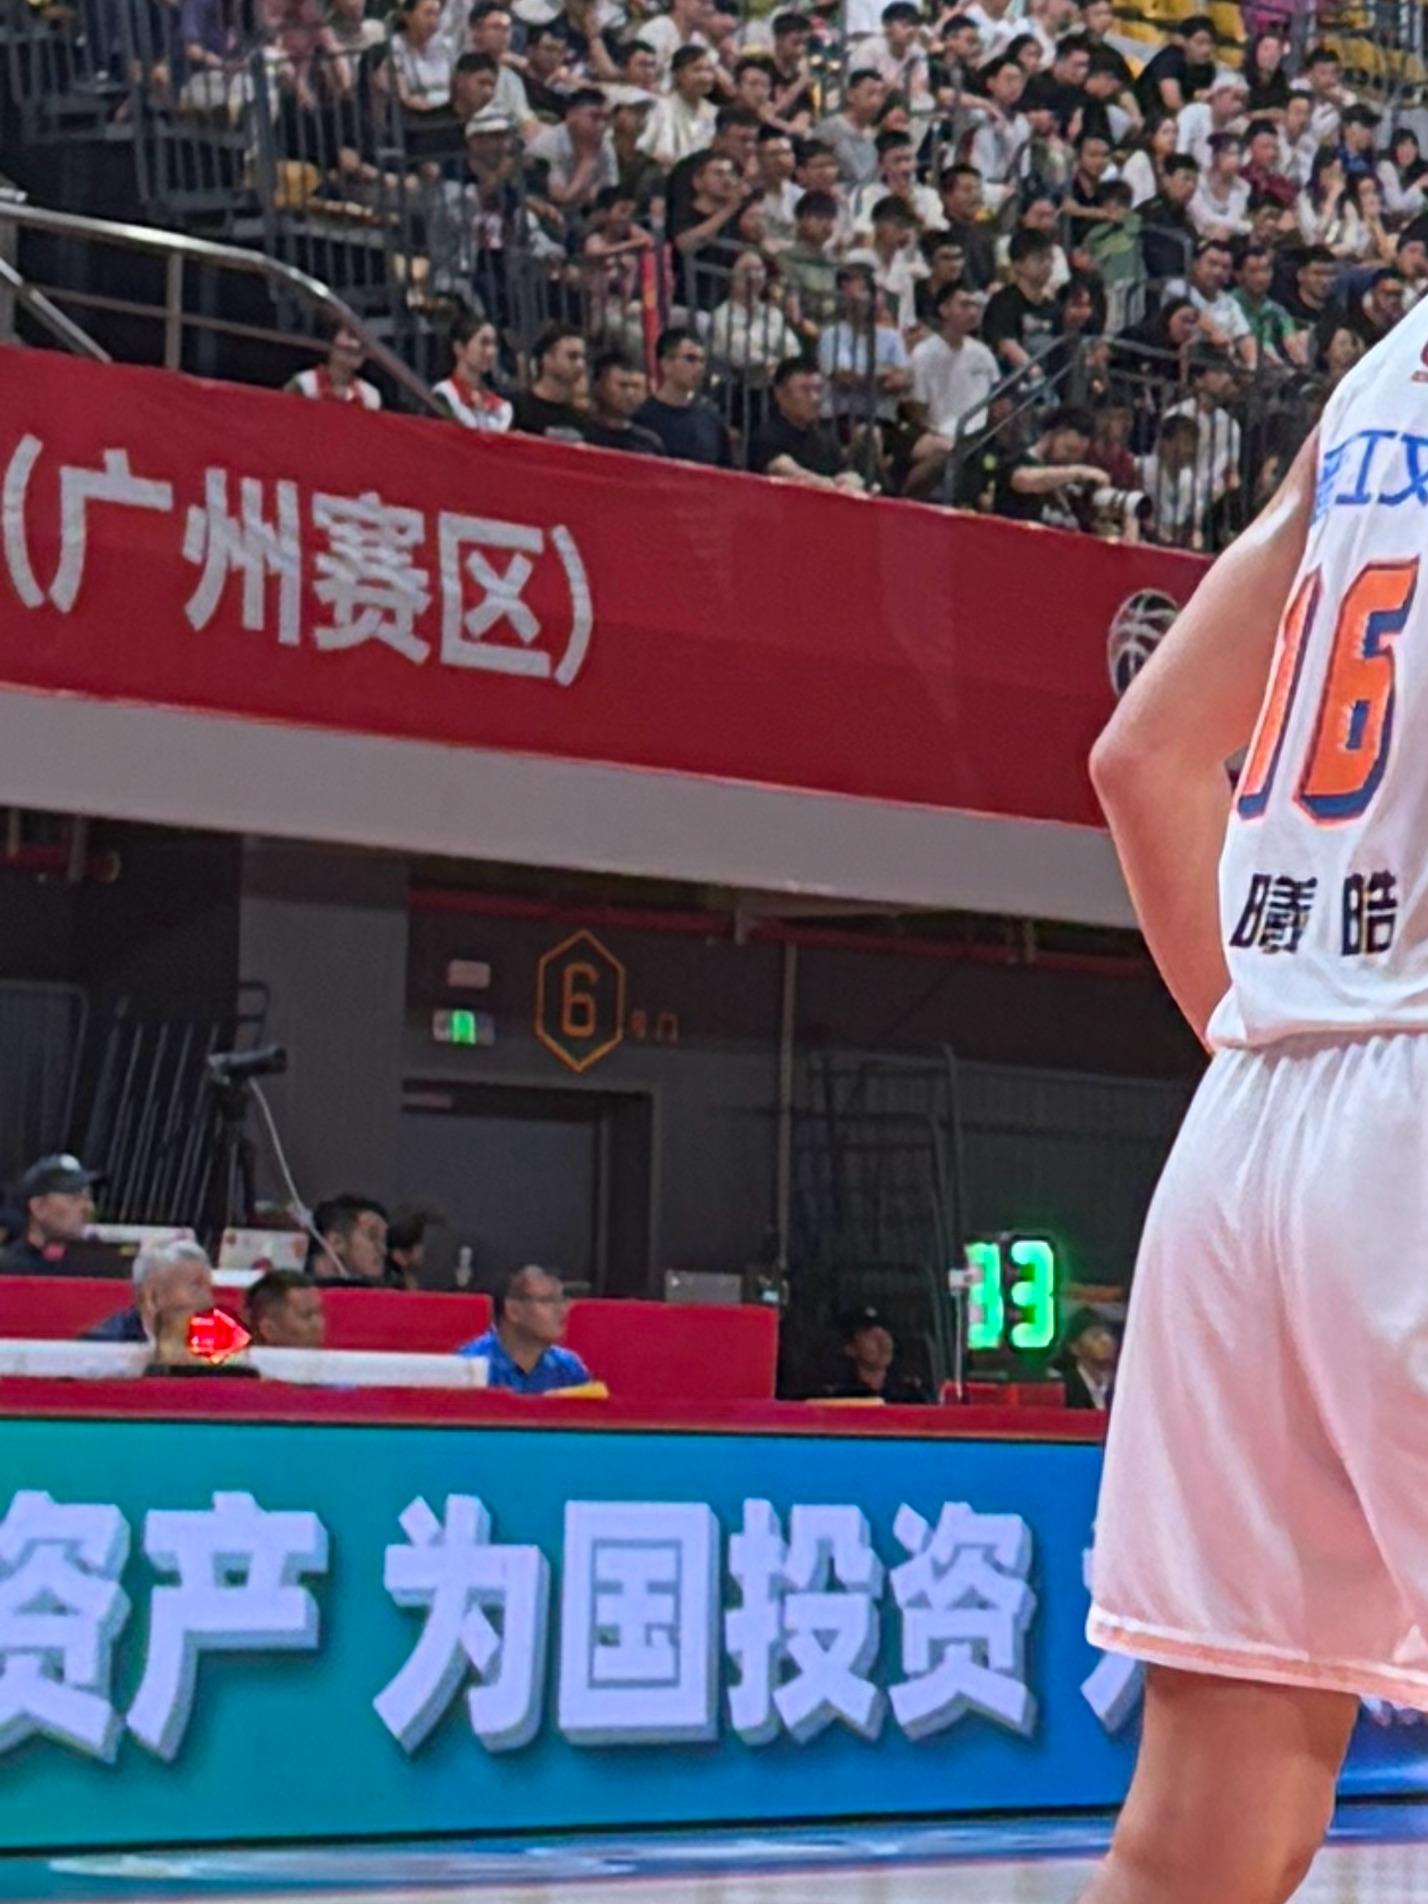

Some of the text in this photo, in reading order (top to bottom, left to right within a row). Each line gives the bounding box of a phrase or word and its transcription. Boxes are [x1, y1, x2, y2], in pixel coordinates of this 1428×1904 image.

[2, 434, 594, 688] (广州赛区)
[1231, 555, 1421, 829] 16
[560, 961, 600, 1038] 6
[0, 1489, 329, 1765] 资产
[373, 1492, 1038, 1754] 为国投资
